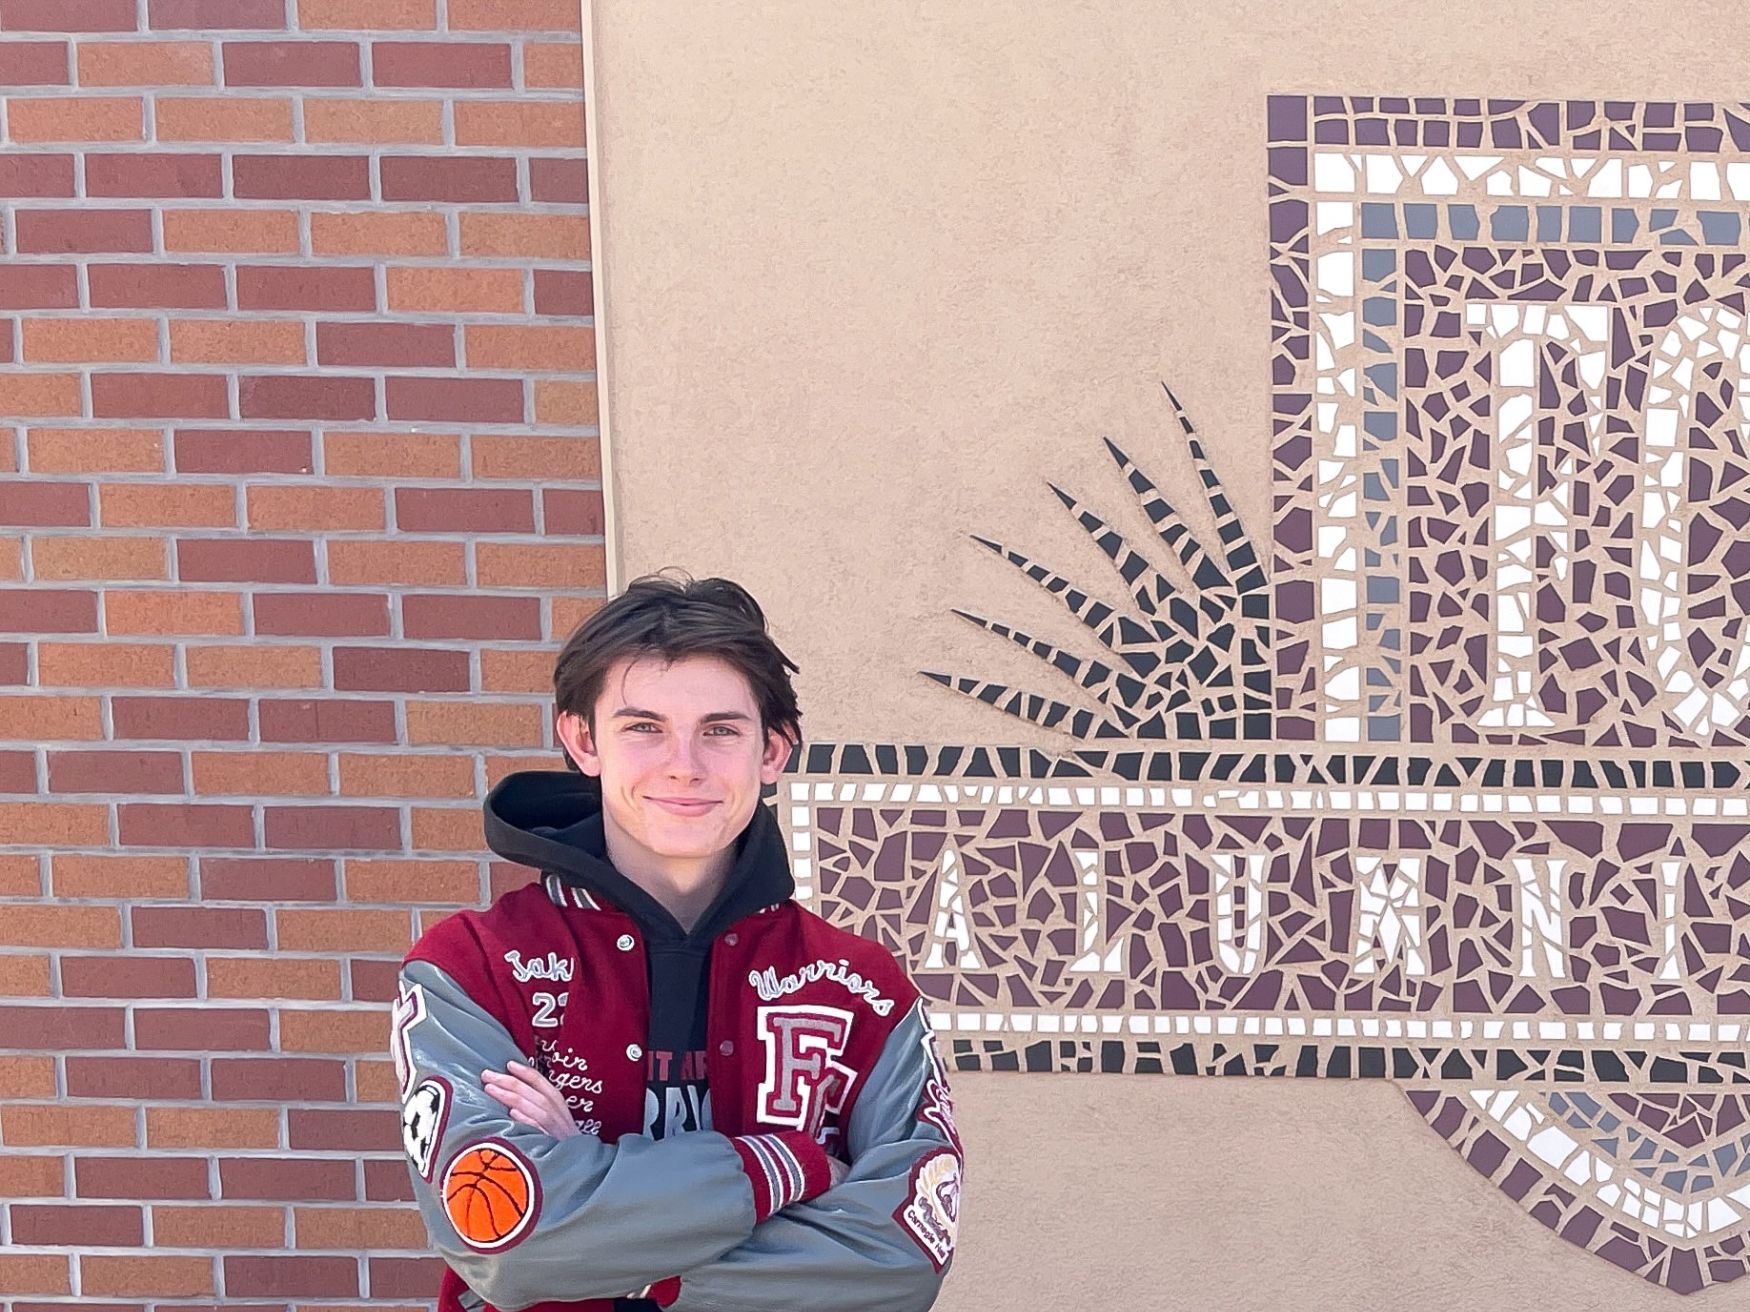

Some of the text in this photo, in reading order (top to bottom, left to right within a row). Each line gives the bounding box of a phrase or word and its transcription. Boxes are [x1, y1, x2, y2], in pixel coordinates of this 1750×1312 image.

[922, 847, 1684, 981] ALUMNI
[504, 949, 575, 983] Jak
[747, 957, 896, 1018] Warriors
